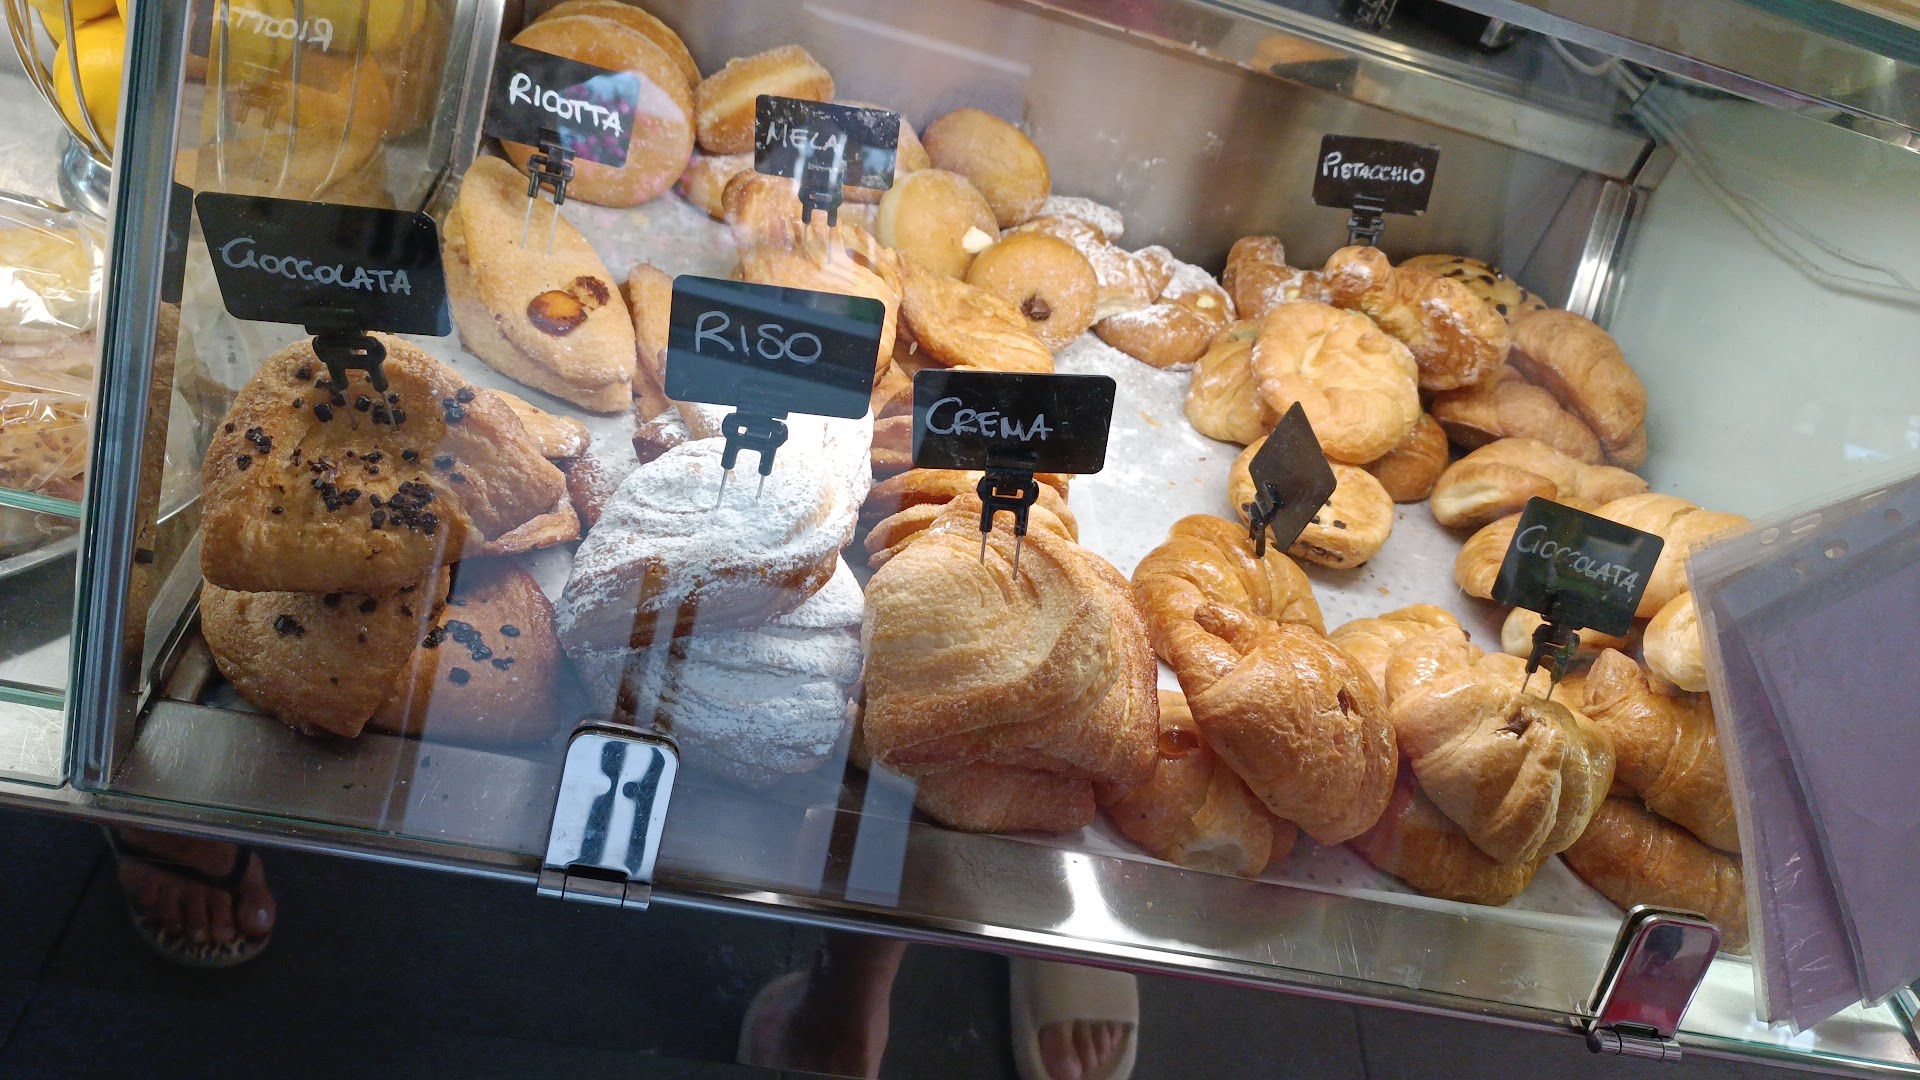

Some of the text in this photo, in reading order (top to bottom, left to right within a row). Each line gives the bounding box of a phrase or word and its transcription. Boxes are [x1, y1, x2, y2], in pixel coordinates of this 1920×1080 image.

[508, 72, 625, 138] RICOTTA
[765, 121, 841, 152] MELA
[1322, 151, 1426, 185] PISTACCHIO
[219, 237, 412, 296] CIOCCOLATA
[694, 310, 822, 364] RISO
[925, 396, 1053, 442] CREMA
[1516, 524, 1639, 594] CIOCCOLATA
